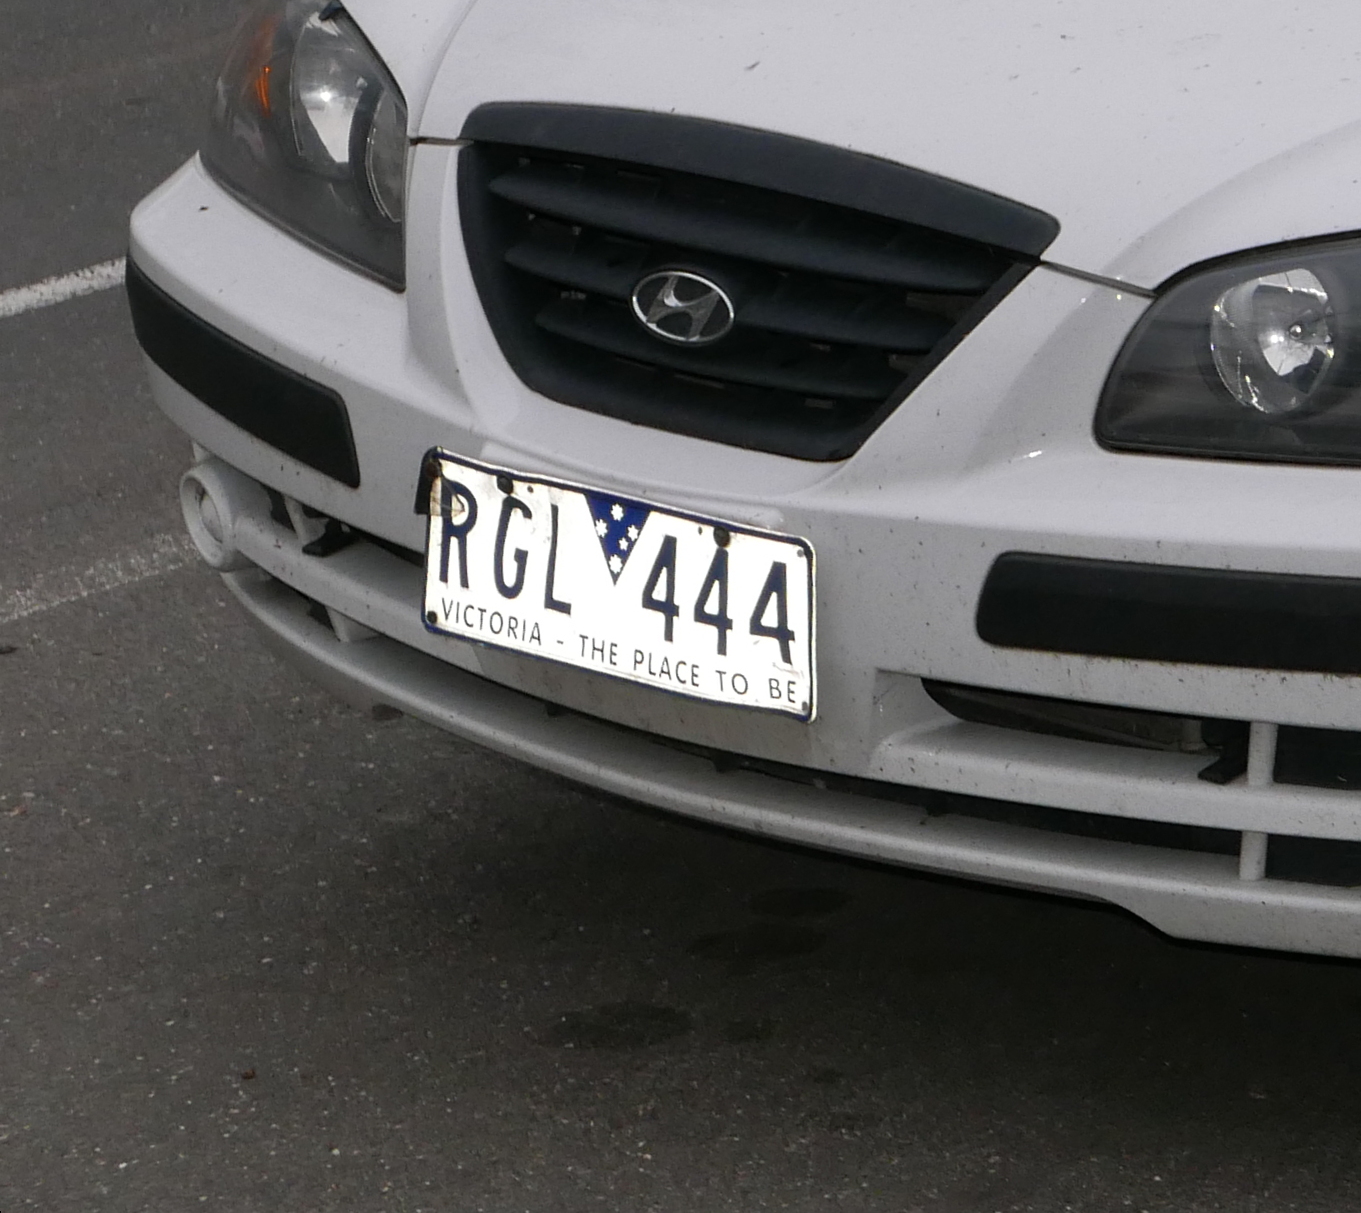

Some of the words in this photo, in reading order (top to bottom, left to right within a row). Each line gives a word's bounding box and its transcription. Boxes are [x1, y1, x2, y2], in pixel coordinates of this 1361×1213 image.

[439, 480, 572, 616] RGL
[641, 534, 796, 665] 444
[441, 597, 542, 647] VICTORIA
[579, 634, 619, 667] THE
[633, 648, 701, 687] PLACE
[715, 670, 749, 696] TO
[769, 678, 798, 704] BE
